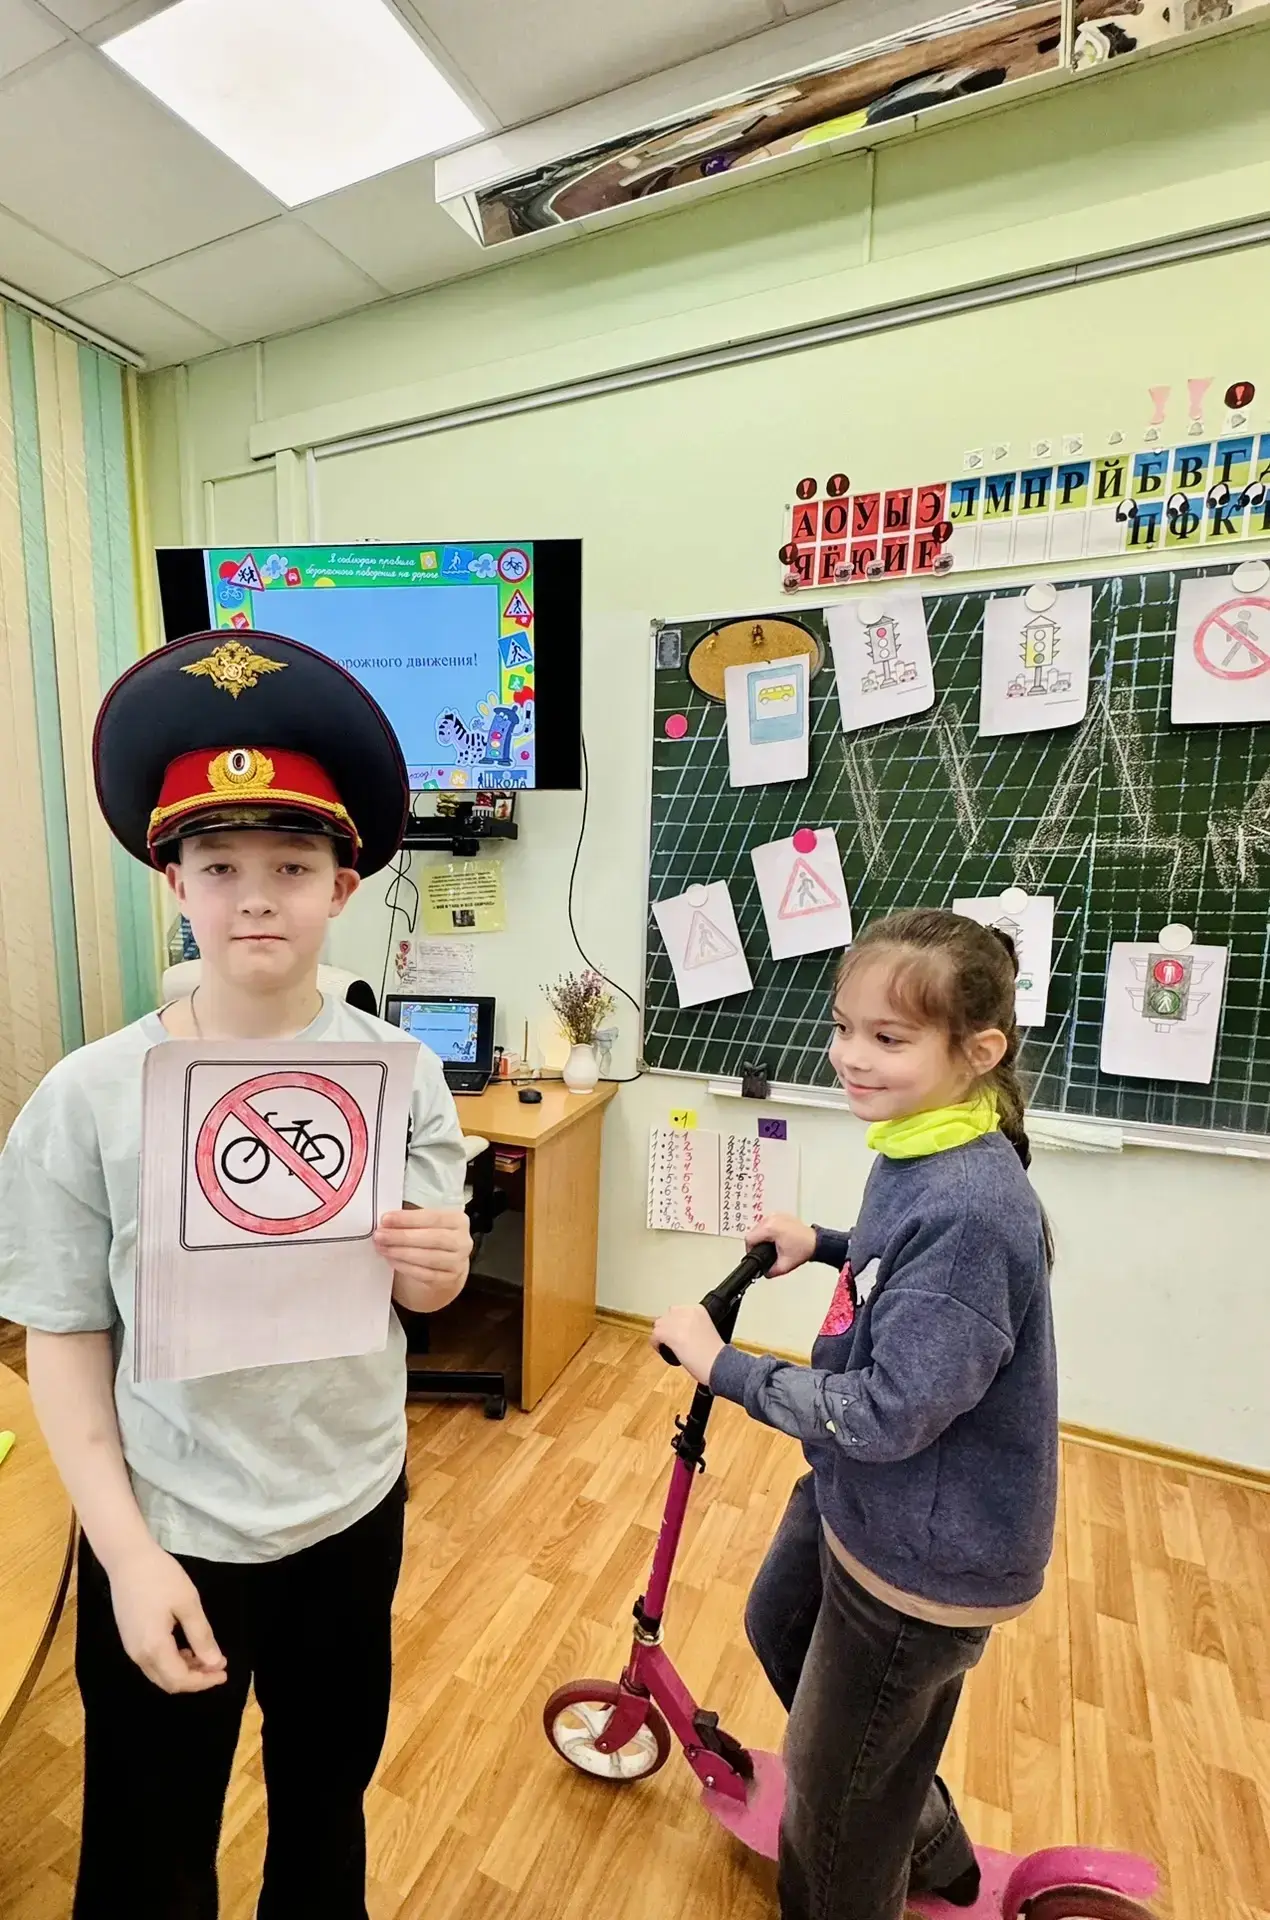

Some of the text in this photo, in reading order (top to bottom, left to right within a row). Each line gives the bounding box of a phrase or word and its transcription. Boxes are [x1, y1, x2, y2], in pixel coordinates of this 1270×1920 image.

[794, 511, 815, 538] А
[824, 505, 847, 534] О
[855, 500, 879, 530] У
[885, 496, 911, 528] Ы
[919, 492, 941, 523] Э
[951, 486, 977, 519] Л
[984, 480, 1014, 515] М
[1021, 475, 1050, 510] Н
[1060, 471, 1085, 505] Р
[1095, 459, 1125, 500] Й
[1136, 461, 1162, 494] Б
[1177, 456, 1203, 489] В
[1221, 449, 1247, 483] Г
[1128, 512, 1160, 545] П
[328, 553, 416, 569] Я соблюдаю правила
[305, 564, 354, 578] безопасного
[356, 567, 397, 580] поведения
[412, 571, 439, 582] дороге
[336, 653, 478, 669] орожного движения!
